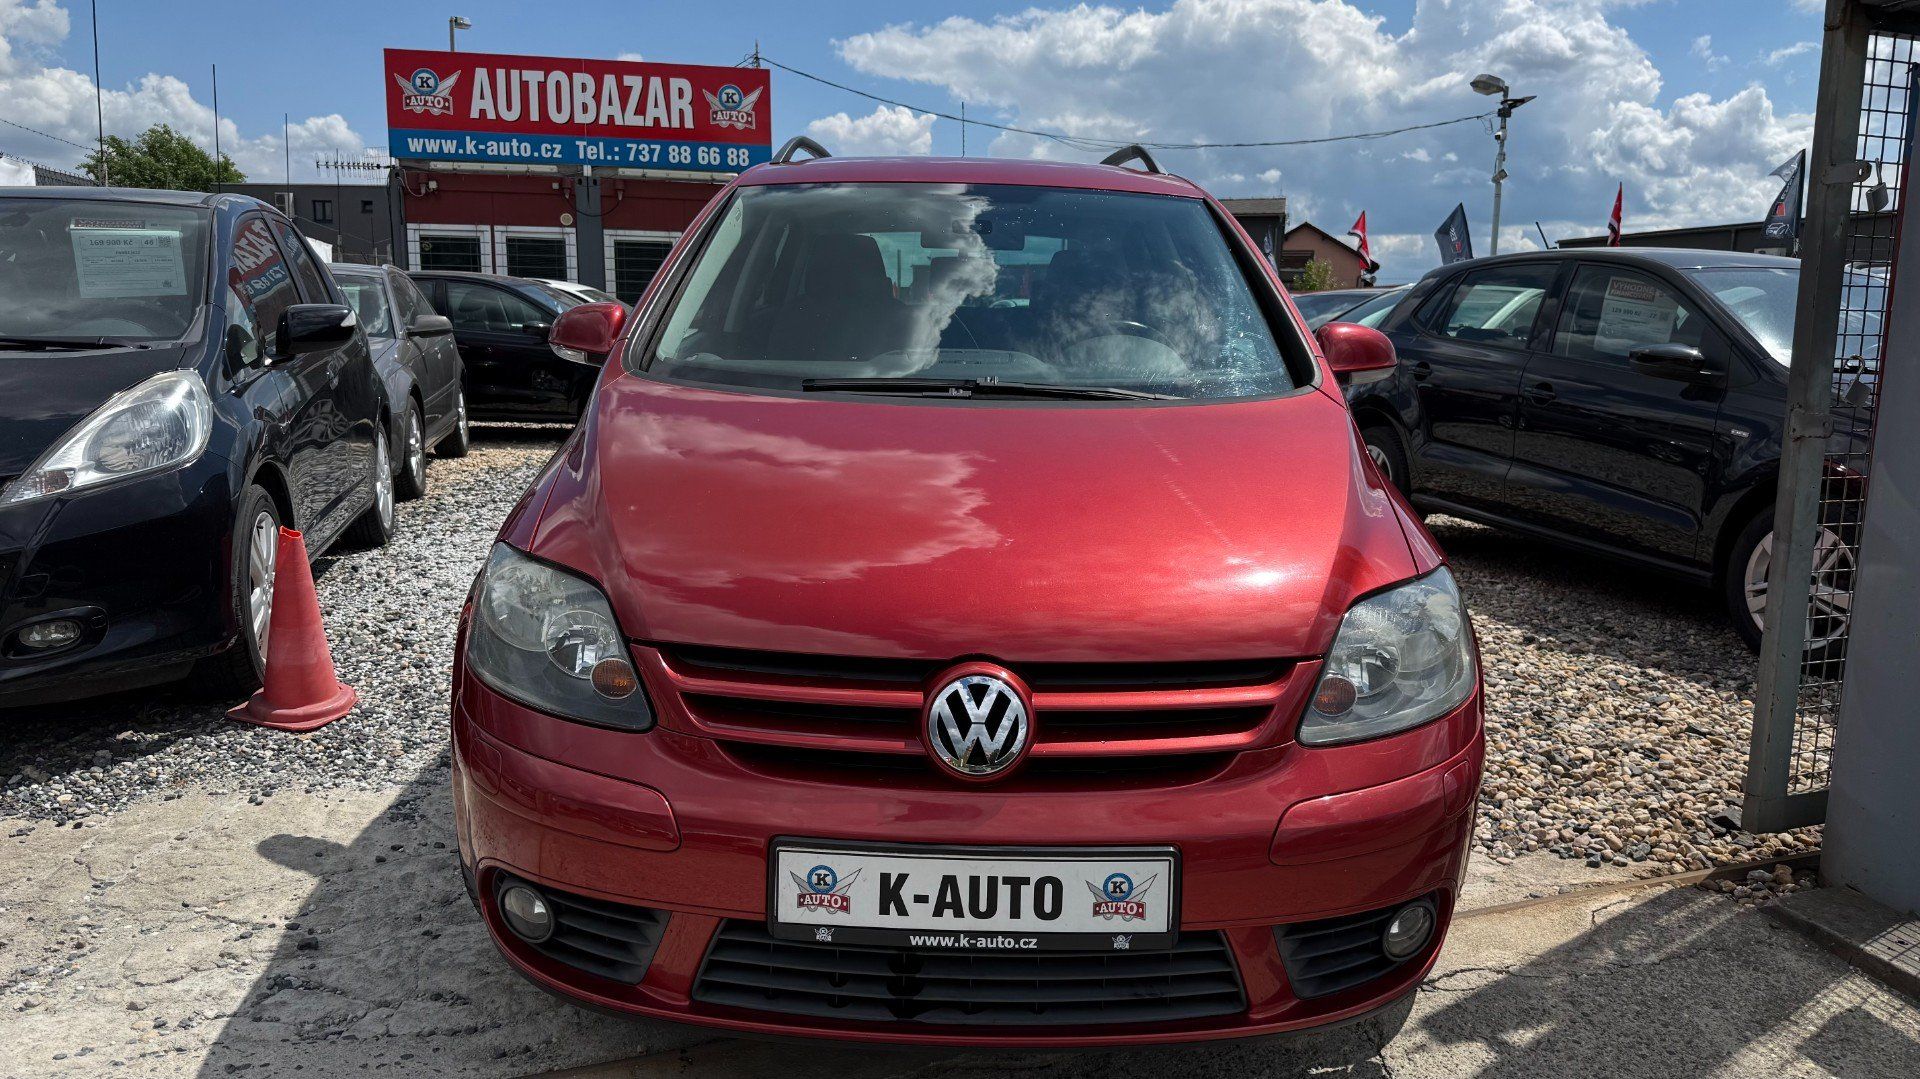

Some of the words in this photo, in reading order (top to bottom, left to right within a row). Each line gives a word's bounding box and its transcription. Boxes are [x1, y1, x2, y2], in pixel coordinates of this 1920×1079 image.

[418, 77, 432, 88] K
[410, 96, 444, 108] AUTO
[469, 67, 694, 129] AUTOBAZAR
[724, 92, 737, 104] K
[716, 110, 748, 123] AUTO
[407, 136, 563, 158] www.k-auto.cz
[575, 141, 620, 161] Tel.:
[626, 143, 661, 163] 737
[668, 145, 692, 164] 88
[697, 146, 721, 166] 66
[727, 148, 750, 167] 88
[814, 873, 830, 887] K
[1110, 881, 1126, 894] K
[803, 894, 842, 908] AUTO
[879, 872, 1063, 921] K-AUTO
[1099, 902, 1138, 915] AUTO
[909, 934, 1038, 949] www.k-auto.cz
